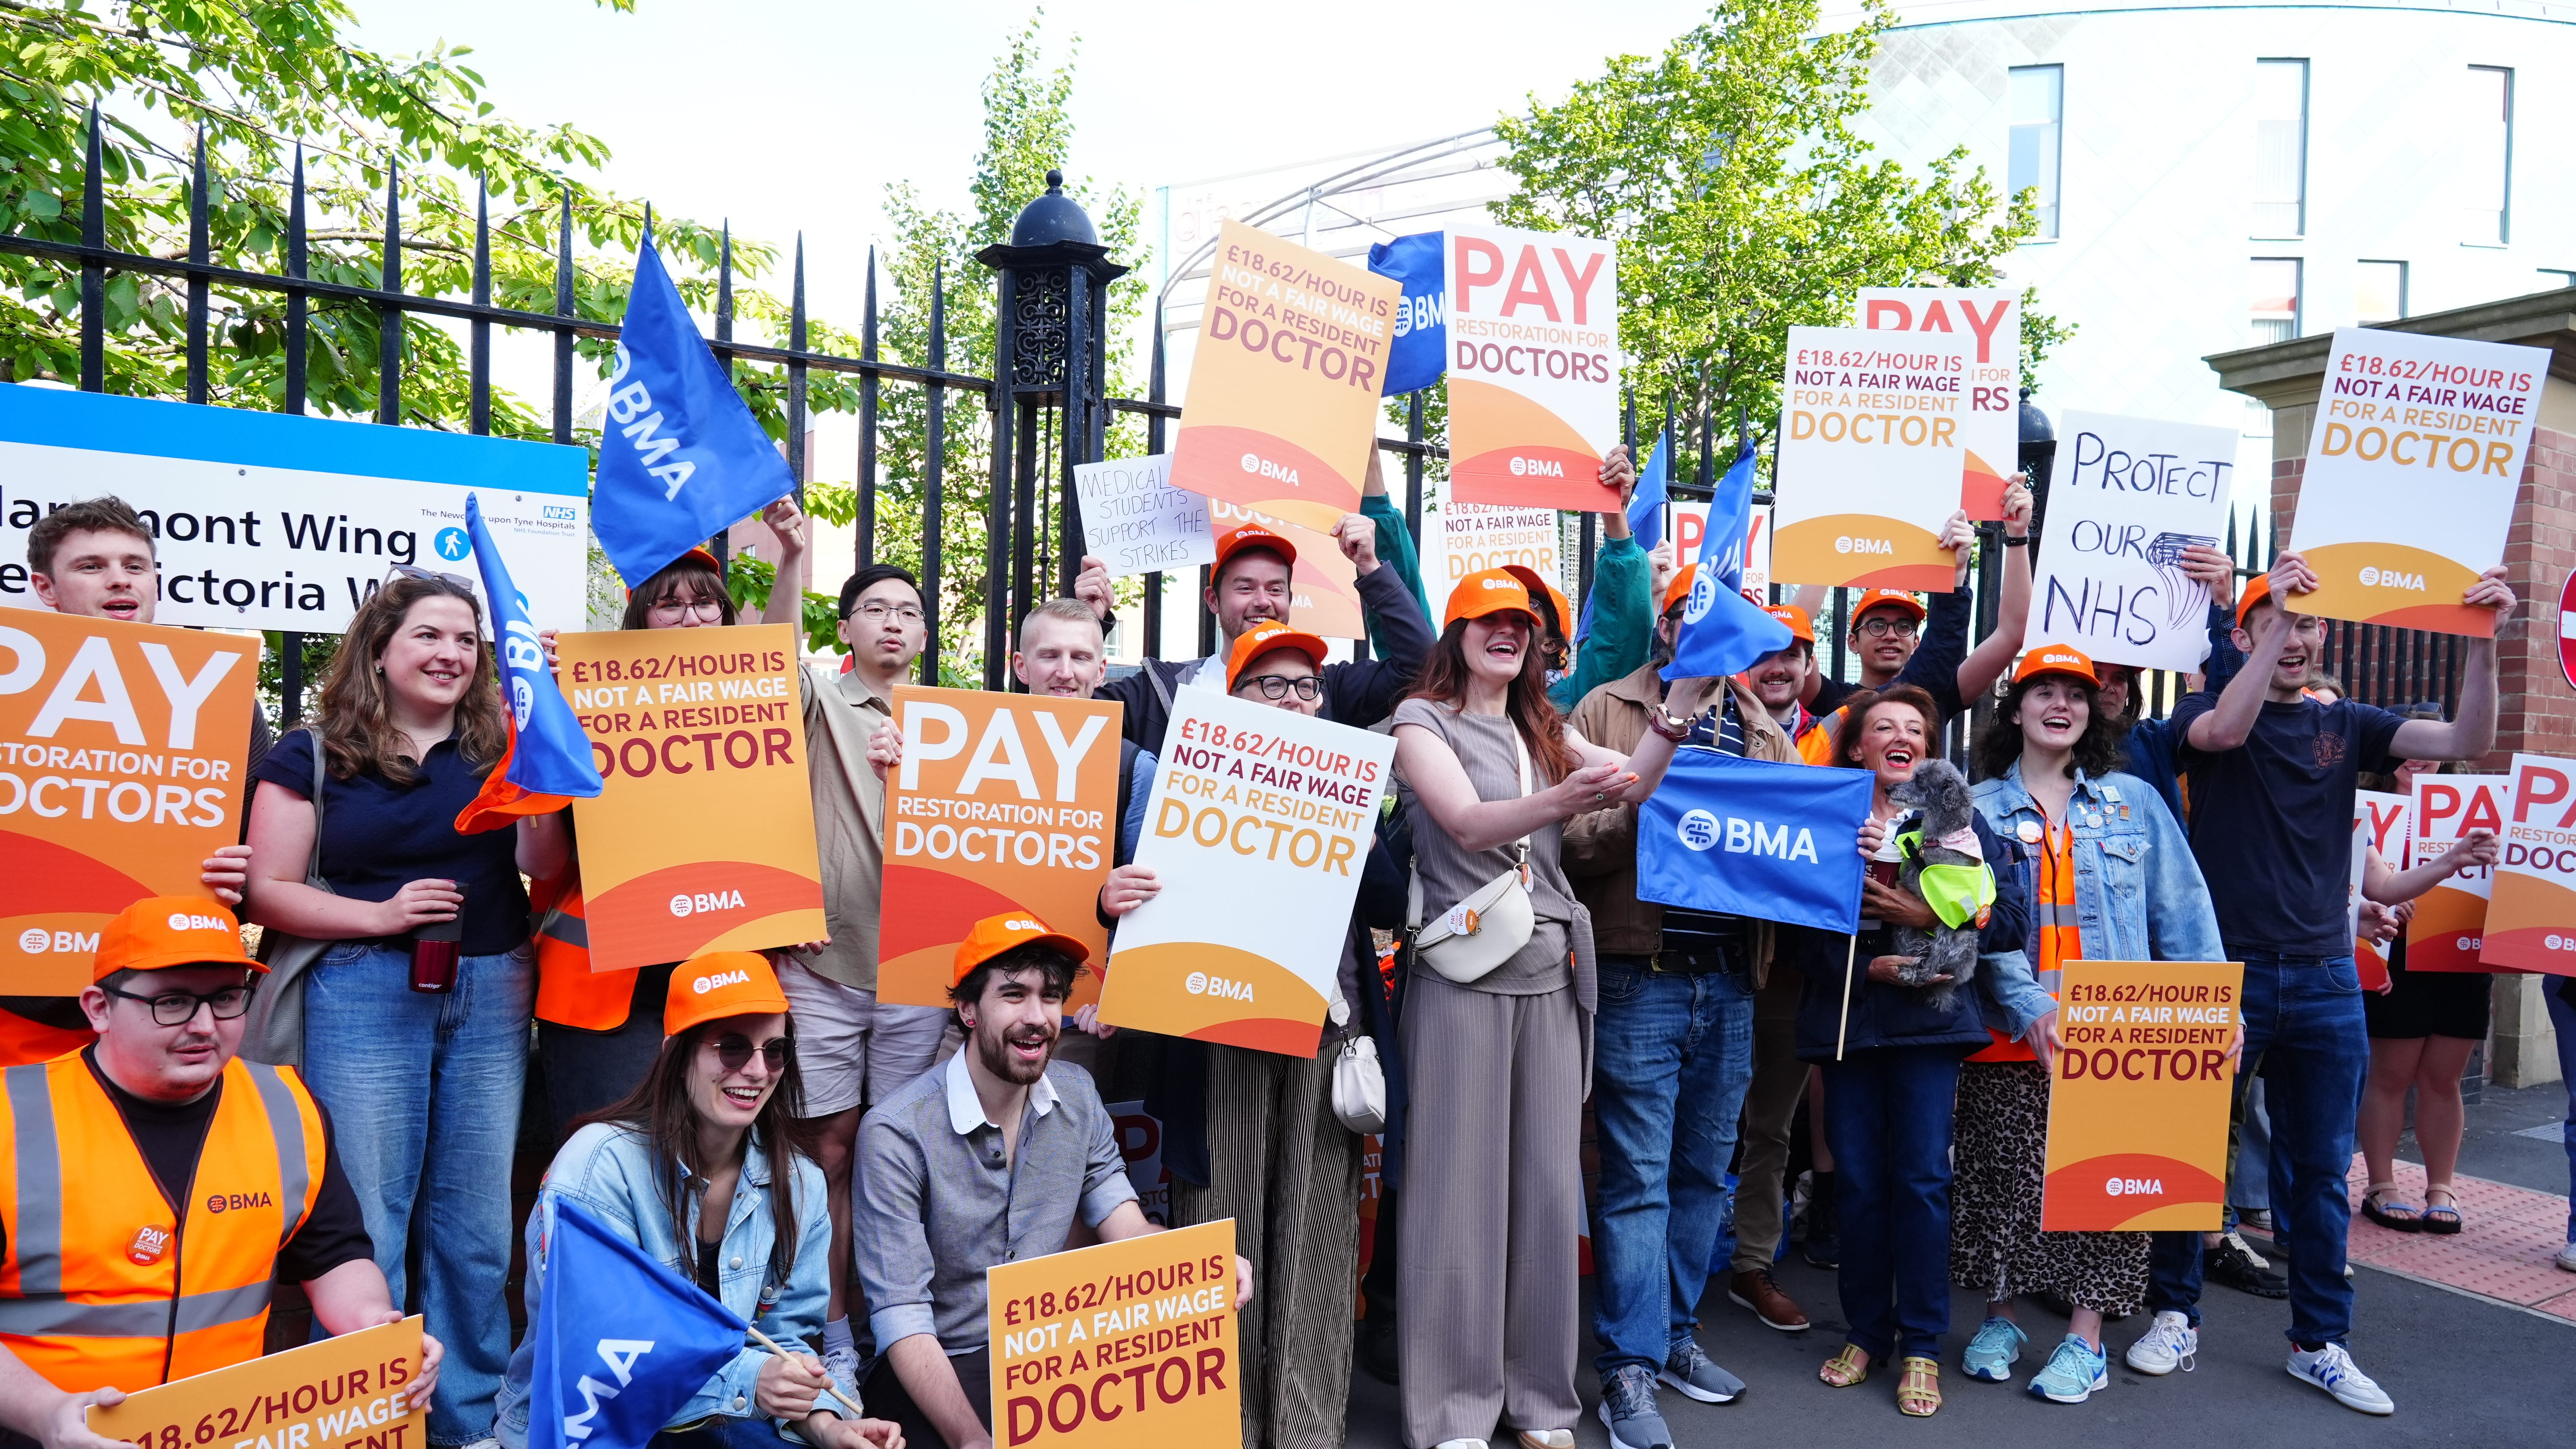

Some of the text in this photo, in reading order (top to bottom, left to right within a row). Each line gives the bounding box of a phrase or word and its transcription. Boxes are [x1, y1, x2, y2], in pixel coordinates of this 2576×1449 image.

[1227, 245, 1388, 316] £18.62/HOUR IS
[1455, 236, 1605, 325] PAY
[1222, 264, 1384, 337] NOT A FAIR WAGE
[1415, 296, 1445, 330] BM
[1218, 286, 1381, 355] FOR A RESIDENT
[1457, 319, 1608, 348] RESTORATION FOR
[1210, 306, 1374, 392] DOCTOR
[1457, 340, 1609, 383] DOCTORS
[1797, 349, 1962, 372] £18.62/HOUR IS
[1795, 371, 1960, 392] NOT A FAIR WAGE
[1980, 369, 2010, 381] FOR
[2341, 354, 2531, 392] £18.62/HOUR IS
[1794, 390, 1833, 406] FOR
[1838, 393, 1851, 407] A
[1858, 393, 1959, 412] RESIDENT
[2335, 377, 2526, 414] NOT A FAIR WAGE
[1791, 411, 1956, 447] DOCTOR
[2330, 400, 2521, 437] FOR A RESIDENT
[608, 380, 696, 502] BMA
[2321, 422, 2513, 477] DOCTOR
[1081, 466, 1172, 499] MEDICAL
[1260, 460, 1298, 486] BMA
[1528, 459, 1563, 477] BMA
[2072, 431, 2233, 503] PROTECT
[421, 509, 437, 517] The
[440, 511, 485, 520] Newce
[514, 518, 534, 527] Tyne
[537, 520, 575, 529] Hospitals
[544, 506, 575, 520] NHS
[1100, 489, 1187, 519] STUDENTS
[281, 511, 416, 565] Wing
[1088, 517, 1157, 548] SUPPORT
[1174, 509, 1203, 535] THE
[1446, 514, 1551, 532] NOT A FAIR WAGE
[2072, 520, 2146, 559] OUR
[1120, 540, 1189, 568] STRIKES
[1447, 530, 1551, 550] FOR A RESIDENT
[1677, 513, 1764, 568] PY
[1854, 538, 1893, 554] BMA
[157, 563, 325, 611] ictoria
[1495, 580, 1521, 591] BMA
[1746, 573, 1764, 583] FOR
[1890, 589, 1908, 600] BMA
[2381, 571, 2424, 591] BMA
[1291, 595, 1314, 609] MA
[1771, 610, 1793, 619] BMA
[2044, 574, 2157, 646] NHS
[573, 652, 784, 682] £18.62/HOUR IS
[2054, 654, 2080, 665] BMA
[574, 677, 788, 709] NOT A FAIR WAGE
[639, 712, 657, 730] A
[664, 702, 789, 729] RESIDENT
[0, 743, 230, 781] TORATION FOR
[899, 701, 1109, 803] PAY
[1182, 718, 1378, 782] £18.62/HOUR IS
[1173, 744, 1371, 808] NOT A FAIR WAGE
[0, 776, 226, 827] OCTORS
[898, 796, 1103, 829] RESTORATION FOR
[1166, 771, 1365, 831] FOR A RESIDENT
[2419, 784, 2508, 838] PA
[896, 822, 1100, 870] DOCTORS
[1155, 797, 1355, 876] DOCTOR
[1725, 817, 1818, 864] BMA
[2509, 826, 2576, 846] RESTOR
[695, 890, 745, 912] BMA
[191, 915, 229, 932] BMA
[53, 931, 100, 953] BM
[711, 969, 750, 989] BMA
[1208, 977, 1253, 1002] BMA
[2071, 984, 2231, 1002] £18.62/HOUR IS
[2068, 1006, 2229, 1023] NOT A FAIR WAGE
[2066, 1027, 2227, 1043] FOR A RESIDENT
[2062, 1048, 2223, 1081] DOCTOR
[230, 1192, 272, 1209] BMA
[2125, 1179, 2162, 1194] BMA
[134, 1242, 161, 1254] DOCTORS
[139, 1227, 170, 1245] PAY
[1005, 1255, 1223, 1326] £18.62/HOUR IS
[1005, 1285, 1224, 1358] NOT A FAIR WAGE
[1007, 1315, 1224, 1390] FOR A RESIDENT
[120, 1370, 368, 1449] 18.62/HOUR
[380, 1358, 407, 1389] IS
[563, 1339, 655, 1449] MA
[1008, 1348, 1226, 1447] DOCTOR
[317, 1392, 409, 1438] WAGE
